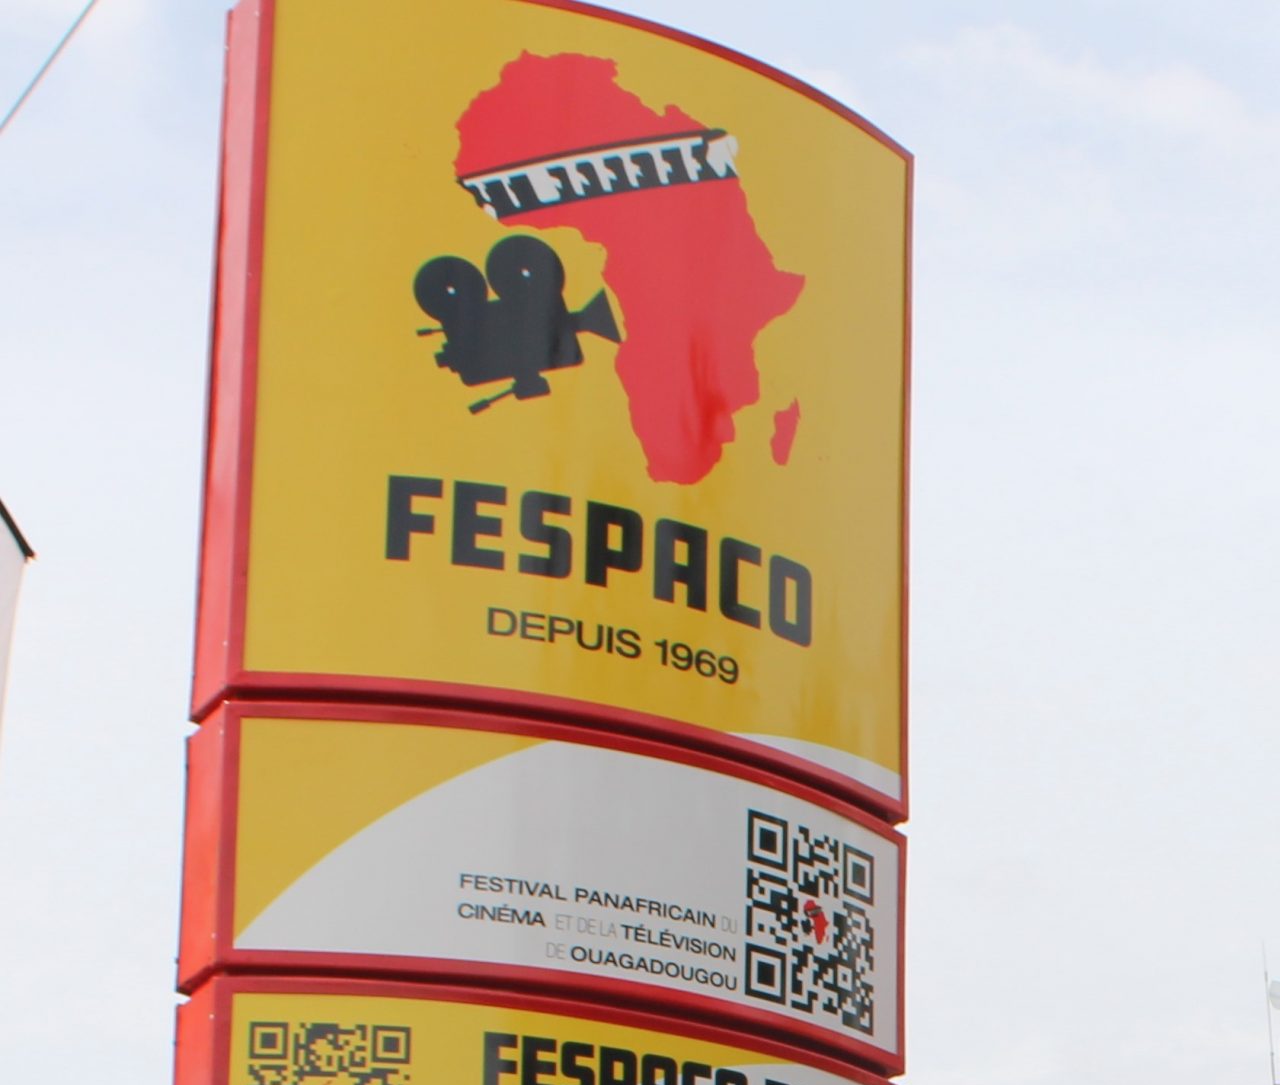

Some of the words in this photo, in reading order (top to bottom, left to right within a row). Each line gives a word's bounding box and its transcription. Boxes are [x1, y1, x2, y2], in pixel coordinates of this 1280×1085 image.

[386, 474, 813, 648] FESPACO
[486, 606, 642, 659] DEPUIS
[654, 639, 739, 685] 1969
[457, 901, 545, 927] CINÉMA
[621, 920, 737, 962] TÉLÉVISION
[459, 873, 567, 901] FESTIVAL
[575, 887, 716, 929] PANAFRICAIN
[546, 942, 566, 960] DE
[571, 945, 738, 991] OUAGADOUGOU
